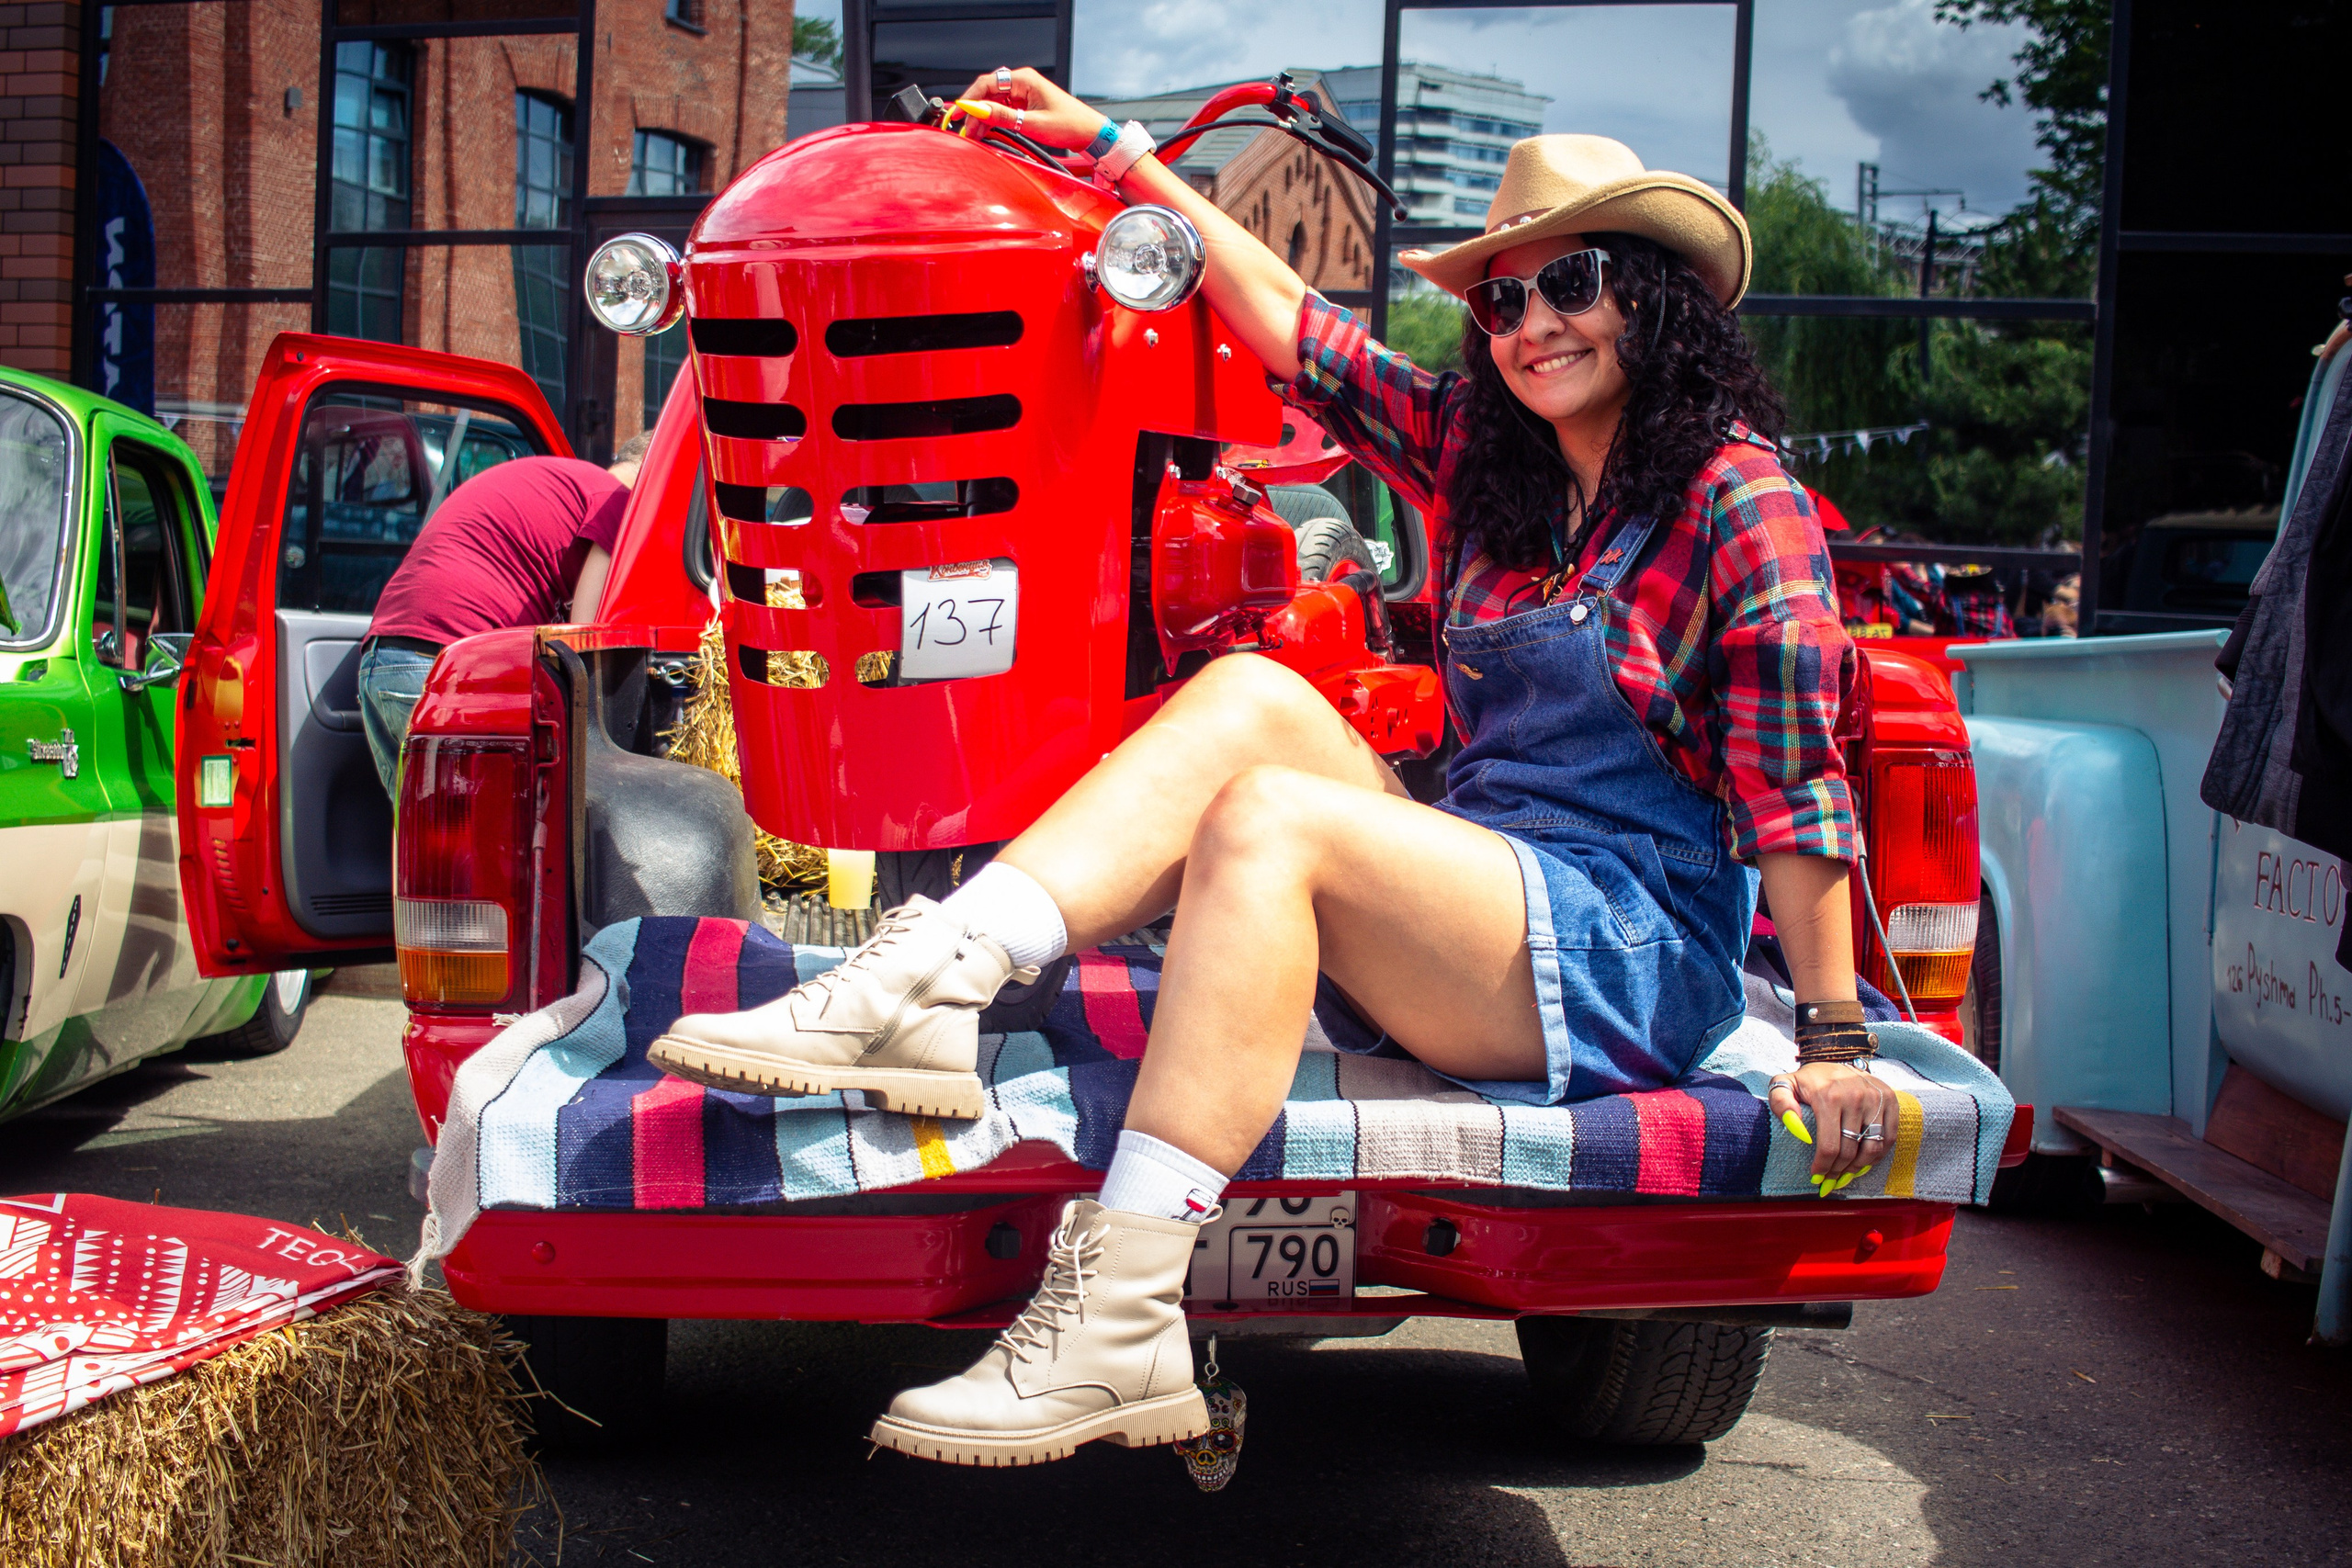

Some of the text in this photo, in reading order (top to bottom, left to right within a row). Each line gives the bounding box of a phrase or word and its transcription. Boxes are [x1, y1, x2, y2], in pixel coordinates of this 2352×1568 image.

[910, 598, 1005, 650] 137
[2247, 942, 2296, 1010] Pyshma
[1247, 1234, 1339, 1279] 790
[1268, 1280, 1308, 1297] RUS
